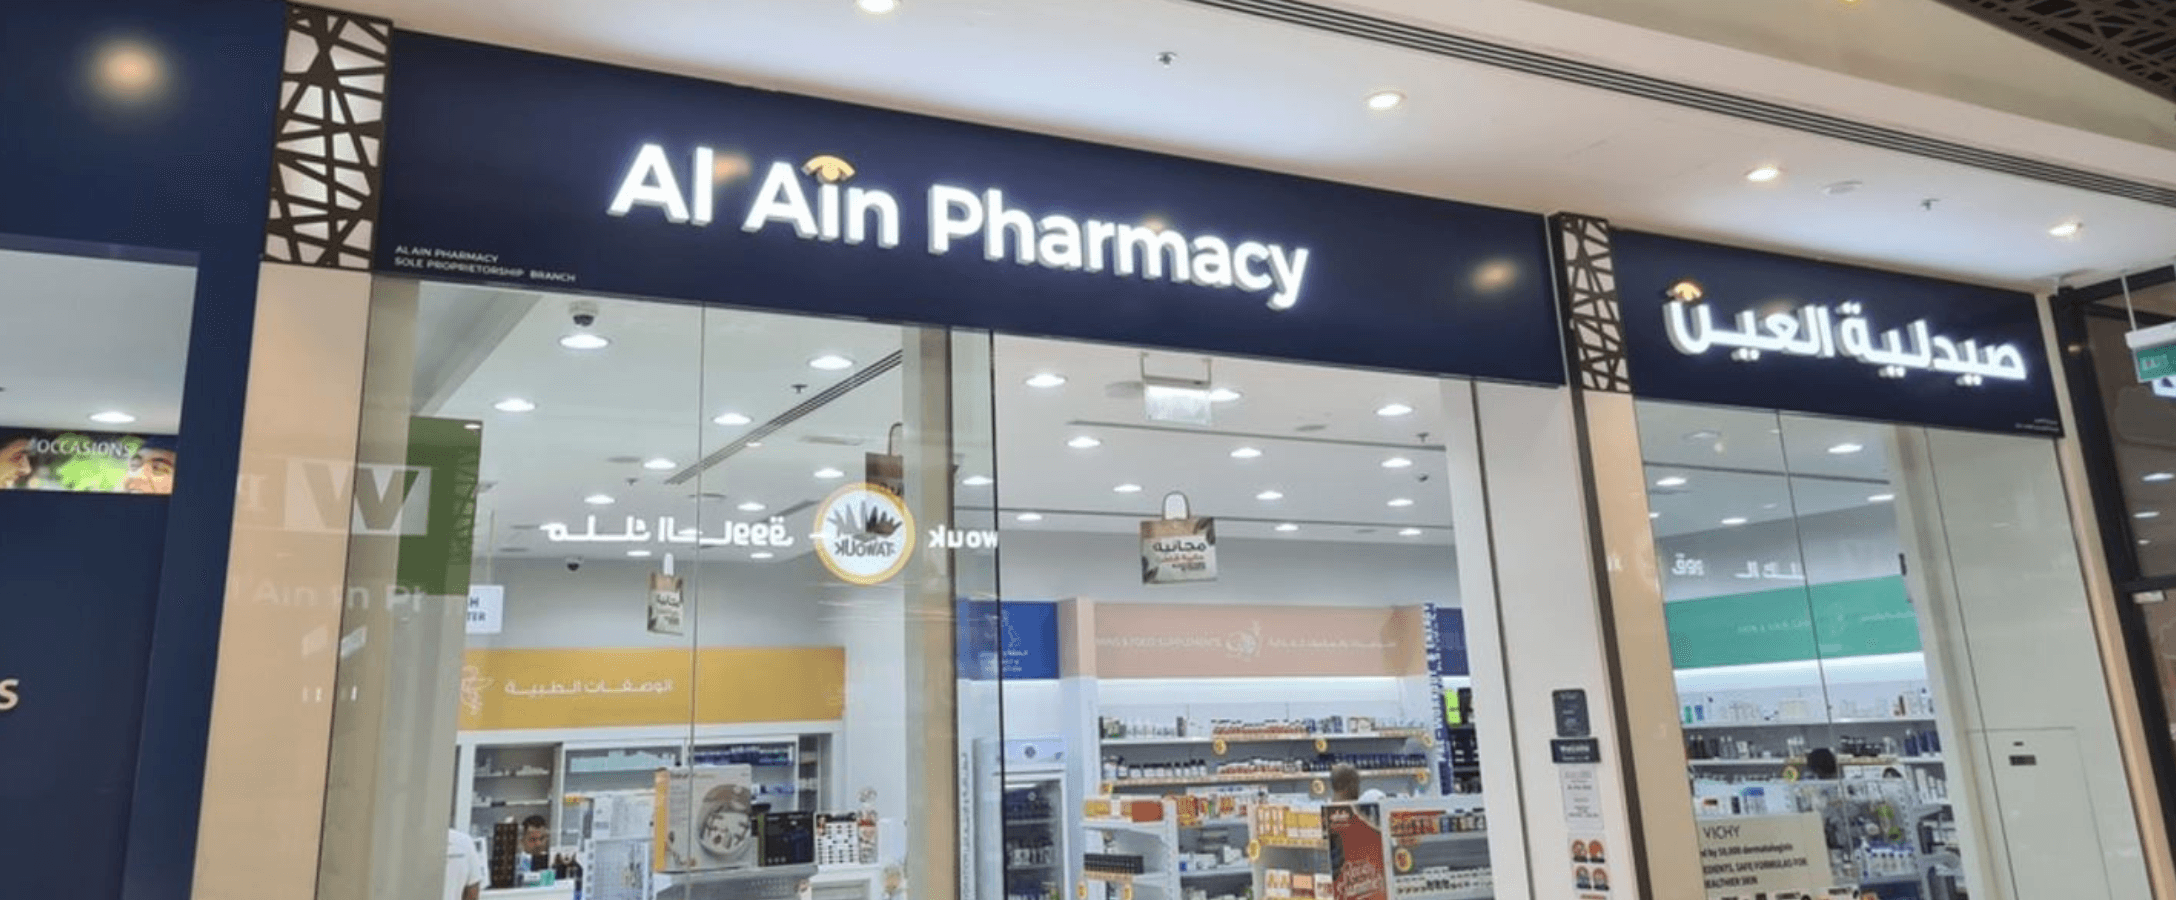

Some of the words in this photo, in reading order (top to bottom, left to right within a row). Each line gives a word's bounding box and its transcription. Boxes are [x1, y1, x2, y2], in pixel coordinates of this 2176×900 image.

[607, 142, 716, 226] Al
[741, 161, 900, 249] Ain
[926, 182, 1310, 311] Pharmacy
[394, 256, 424, 268] SOLE
[427, 259, 524, 276] PROPRIETORSHIP
[530, 270, 577, 282] BRANCH
[435, 248, 499, 264] PHARMACY
[1663, 300, 1835, 362] العين
[1836, 300, 2027, 386] صيدلية
[1702, 825, 1740, 839] VICHY
